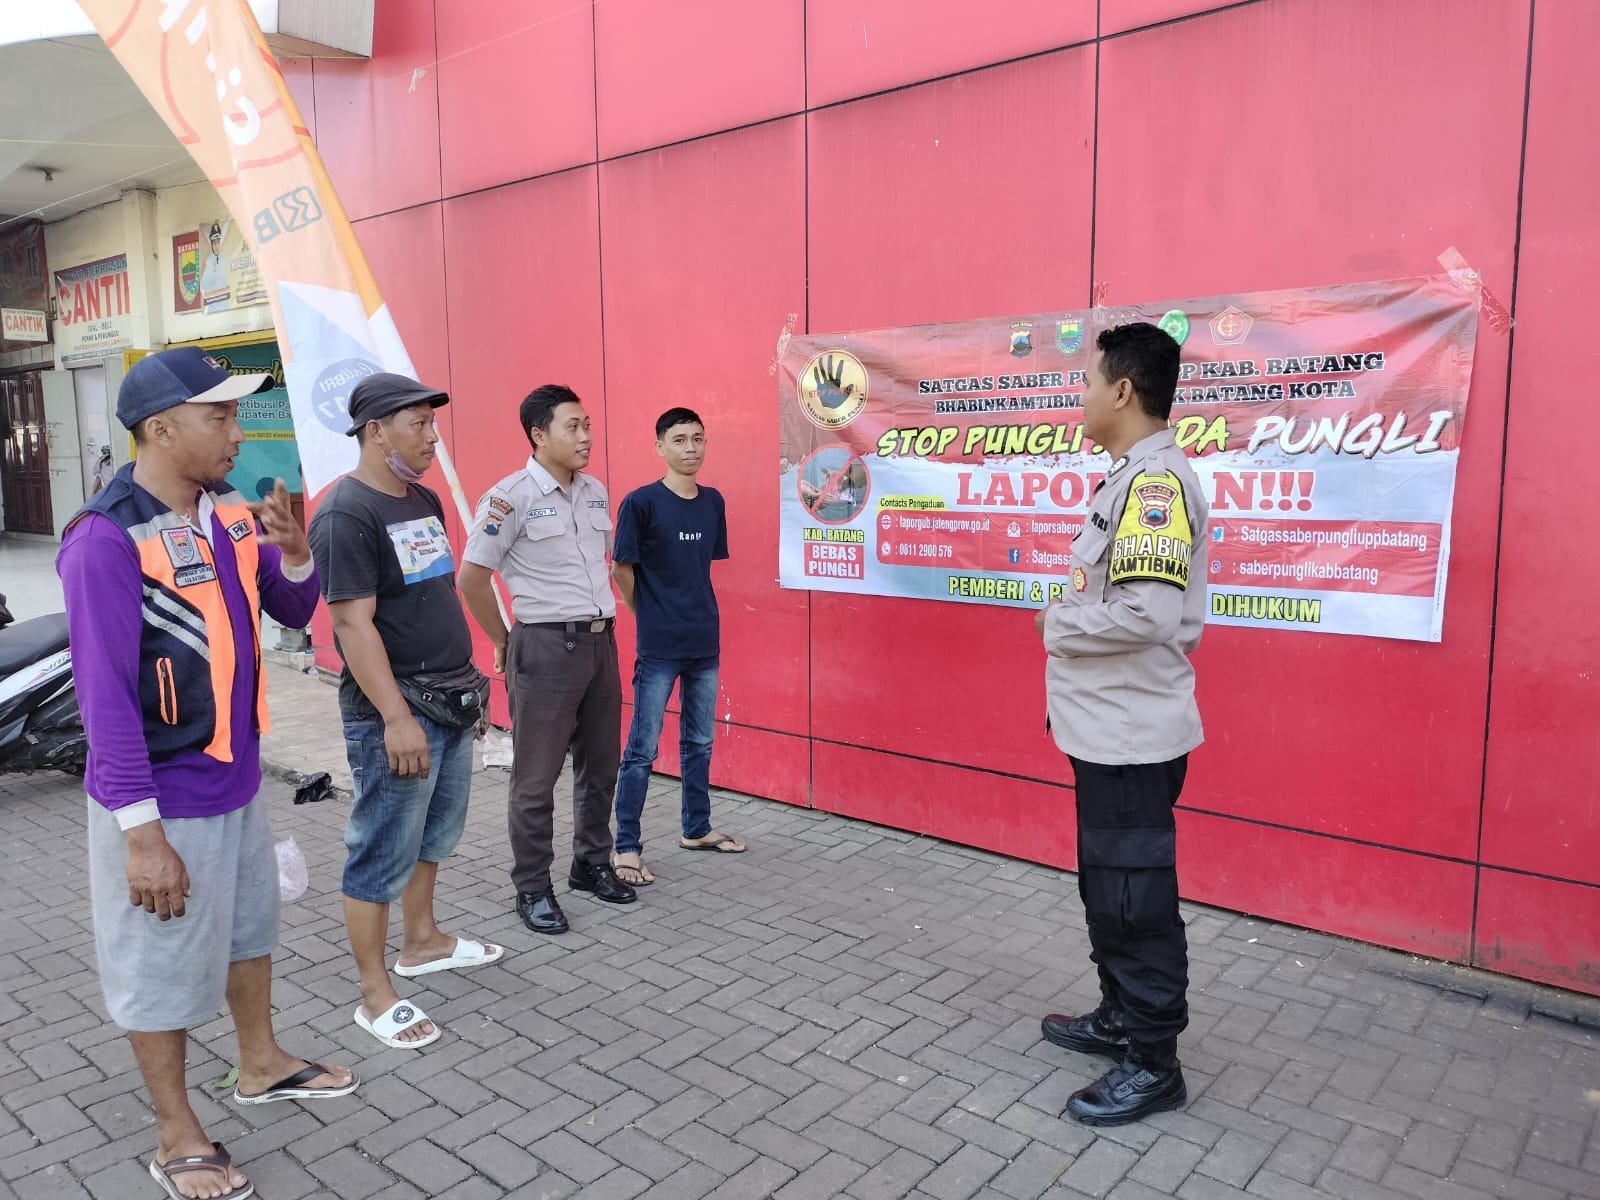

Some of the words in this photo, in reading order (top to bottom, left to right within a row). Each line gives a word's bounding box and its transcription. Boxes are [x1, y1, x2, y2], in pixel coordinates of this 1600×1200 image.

[5, 315, 45, 333] CANTIK
[919, 376, 994, 394] SATGAS
[998, 372, 1064, 390] SABER
[1201, 360, 1260, 379] KAB.
[1265, 352, 1385, 376] BATANG
[237, 400, 276, 409] etibusi
[936, 394, 1085, 414] BHABINKAMTIBM
[1190, 384, 1284, 403] BATANG
[1288, 380, 1357, 399] KOTA
[236, 411, 276, 420] upaten
[877, 425, 960, 457] STOP
[962, 424, 1084, 457] PUNGLI
[1248, 410, 1455, 459] PUNGLI
[880, 497, 908, 508] Contacts
[908, 499, 945, 511] Pengaduan
[826, 528, 865, 543] BATANG
[899, 516, 990, 534] laporgub.jatengprov.go.id
[1240, 525, 1428, 552] Satgassaberpungliuppbatang
[812, 544, 857, 561] BEBAS
[1113, 533, 1192, 566] BHABIN
[808, 560, 860, 578] PUNGLI
[1111, 556, 1189, 582] KAMTIBMAS
[1239, 560, 1379, 584] saberpunglikabbatang
[948, 576, 1025, 601] PEMBERI
[1030, 581, 1044, 603] &
[1211, 592, 1322, 624] DIHUKUM
